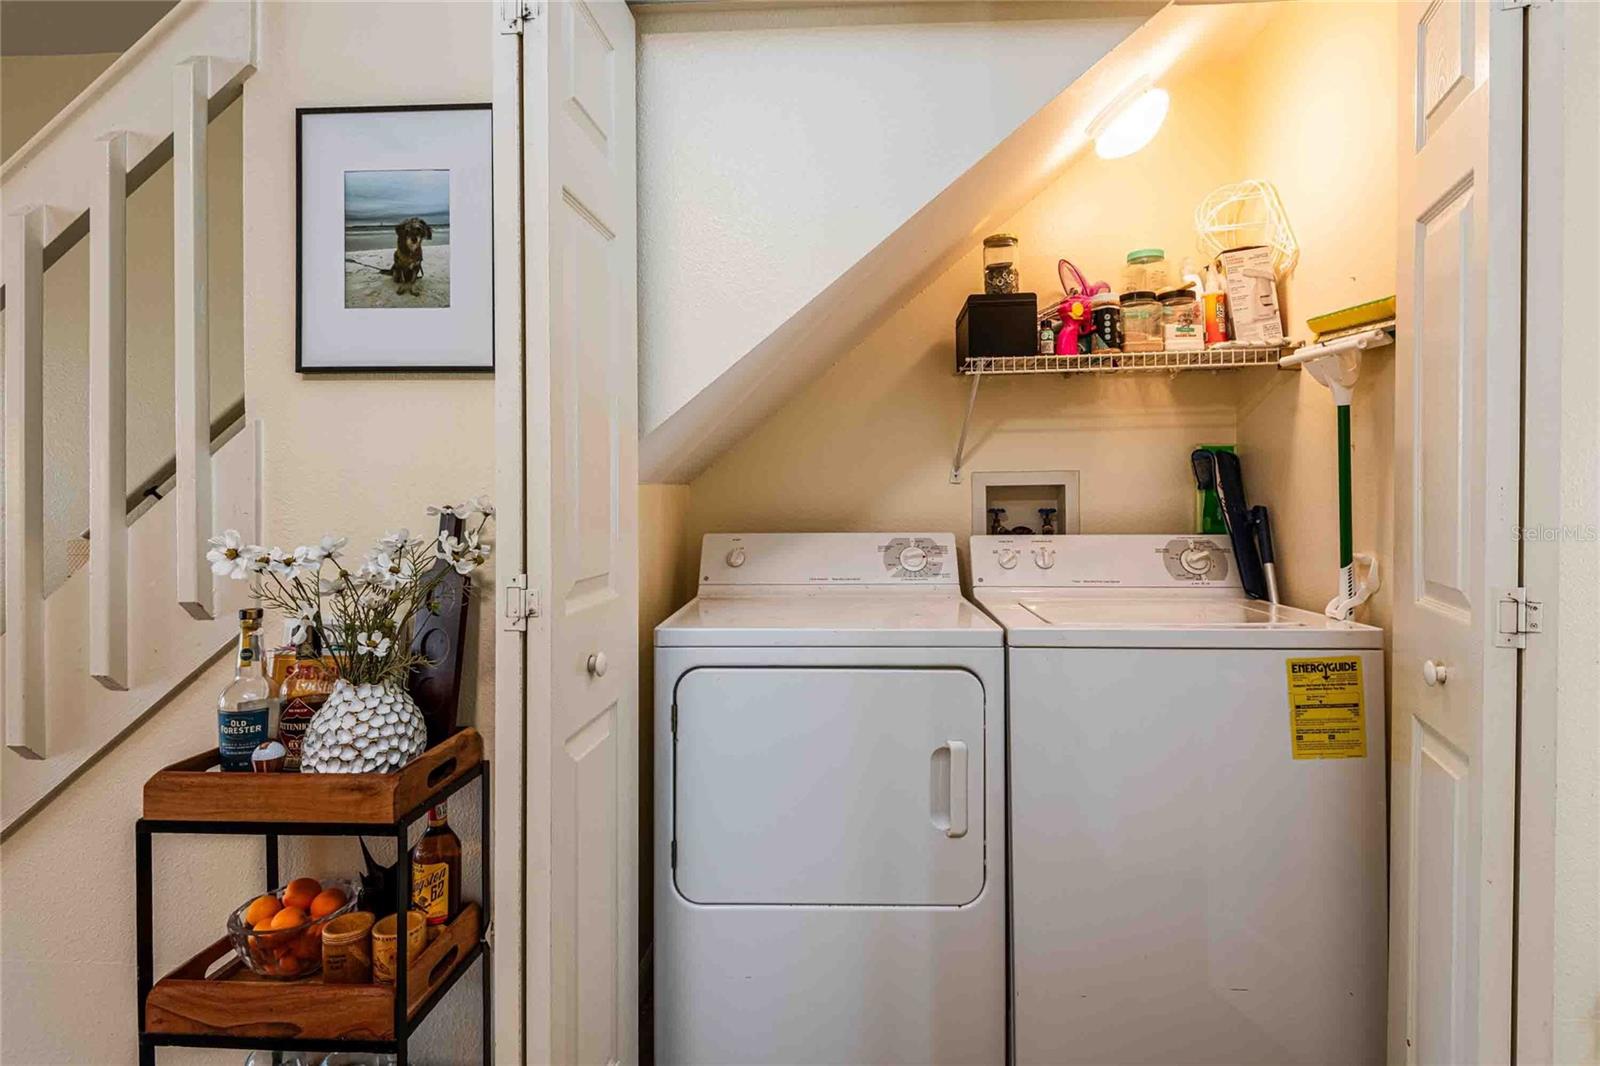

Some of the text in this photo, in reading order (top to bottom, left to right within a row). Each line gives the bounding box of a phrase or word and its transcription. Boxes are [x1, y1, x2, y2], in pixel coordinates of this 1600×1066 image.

[1291, 661, 1358, 675] ENERGYGUIDE
[230, 719, 247, 727] OLD
[220, 724, 262, 735] FORESTER
[430, 878, 444, 902] 62
